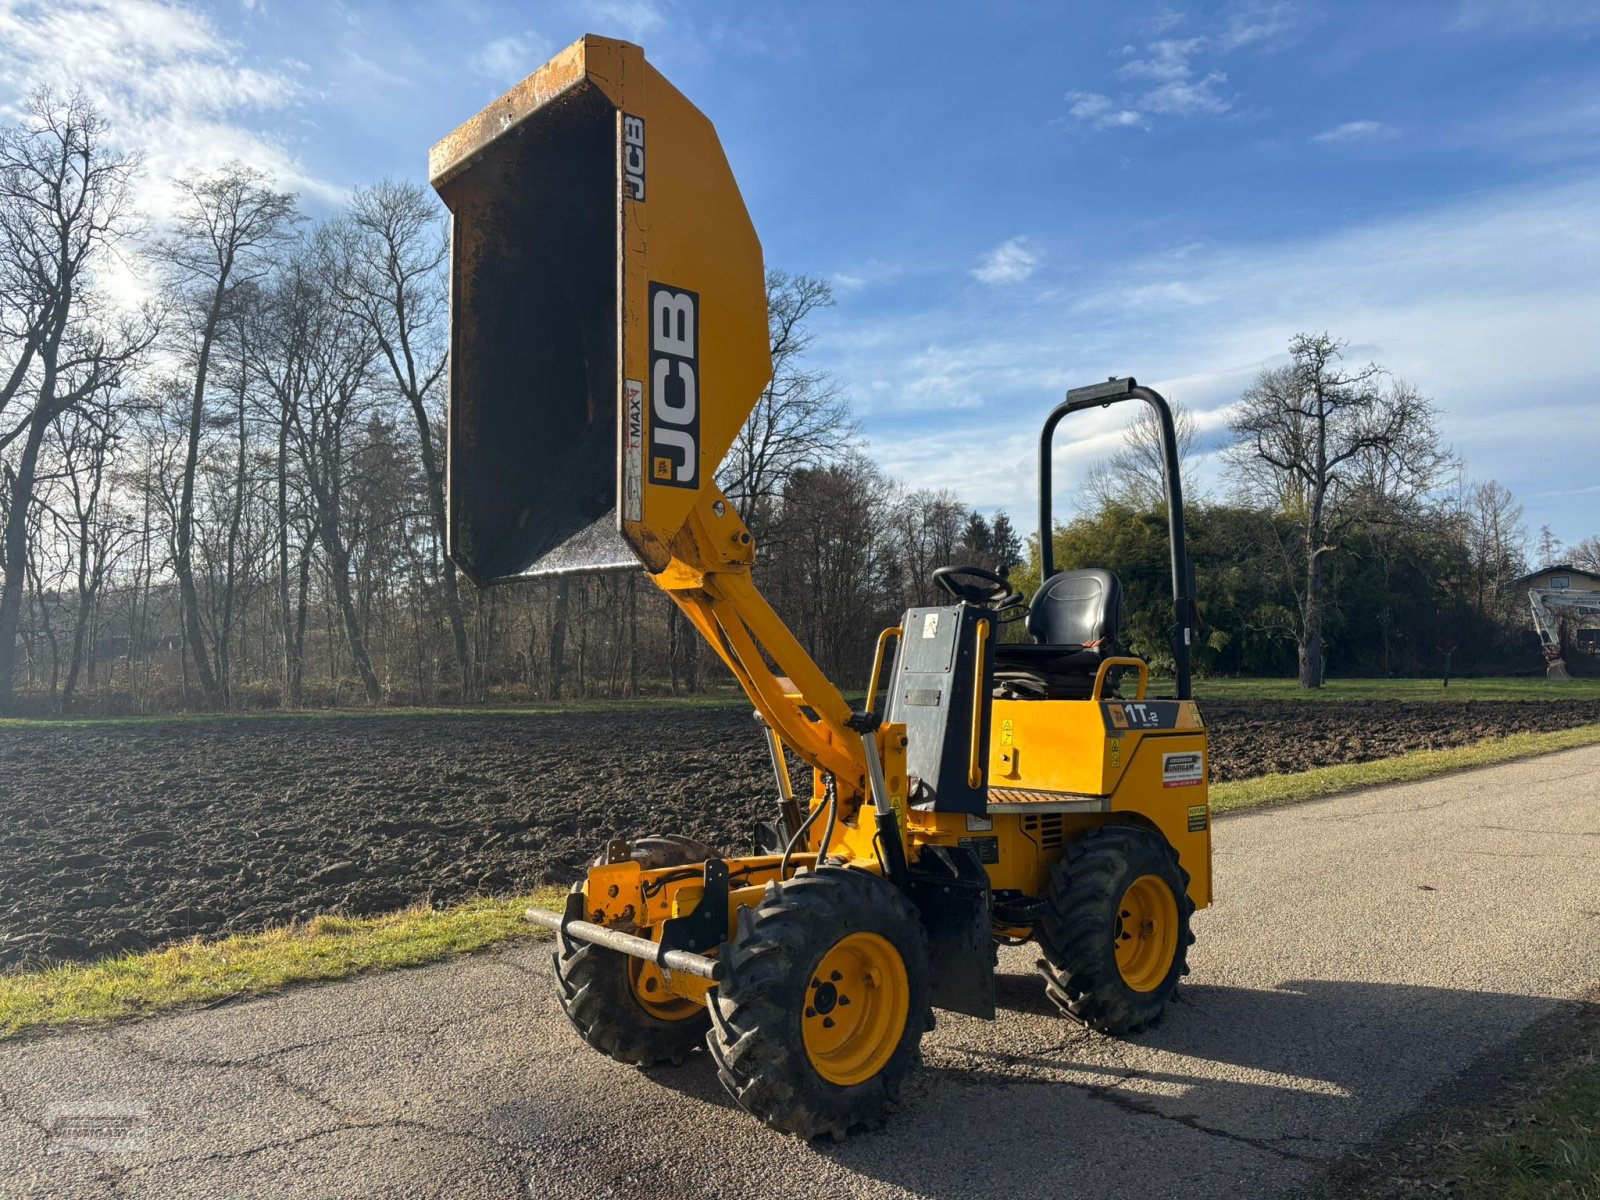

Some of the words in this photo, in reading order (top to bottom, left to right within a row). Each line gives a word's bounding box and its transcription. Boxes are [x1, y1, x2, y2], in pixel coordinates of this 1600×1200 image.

[624, 115, 645, 200] JCB
[630, 399, 641, 438] MAX
[653, 289, 696, 483] JCB
